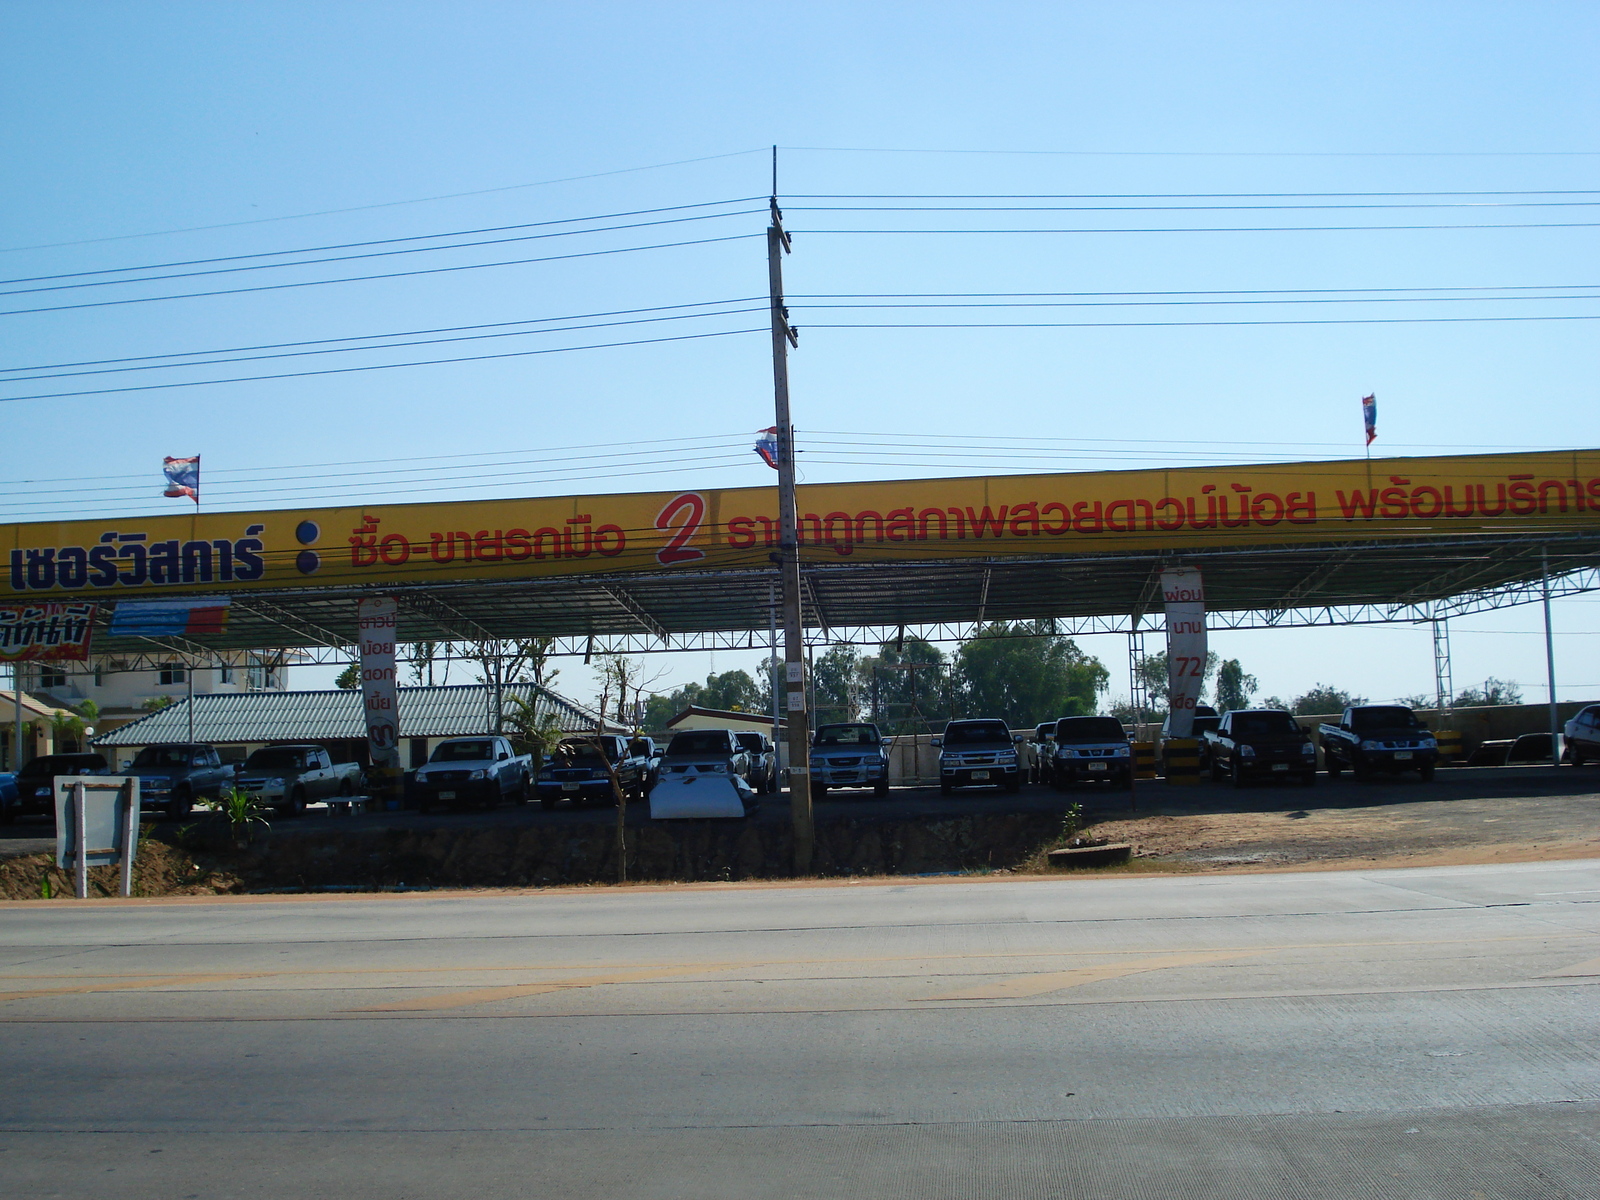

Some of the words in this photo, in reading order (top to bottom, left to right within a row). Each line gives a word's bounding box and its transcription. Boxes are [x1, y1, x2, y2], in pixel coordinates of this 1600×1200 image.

[656, 492, 704, 566] 2
[1174, 620, 1202, 635] นาน
[362, 639, 394, 656] น้อย
[362, 667, 394, 681] ดอก
[1176, 657, 1202, 677] 72
[367, 690, 391, 711] เบี้ย
